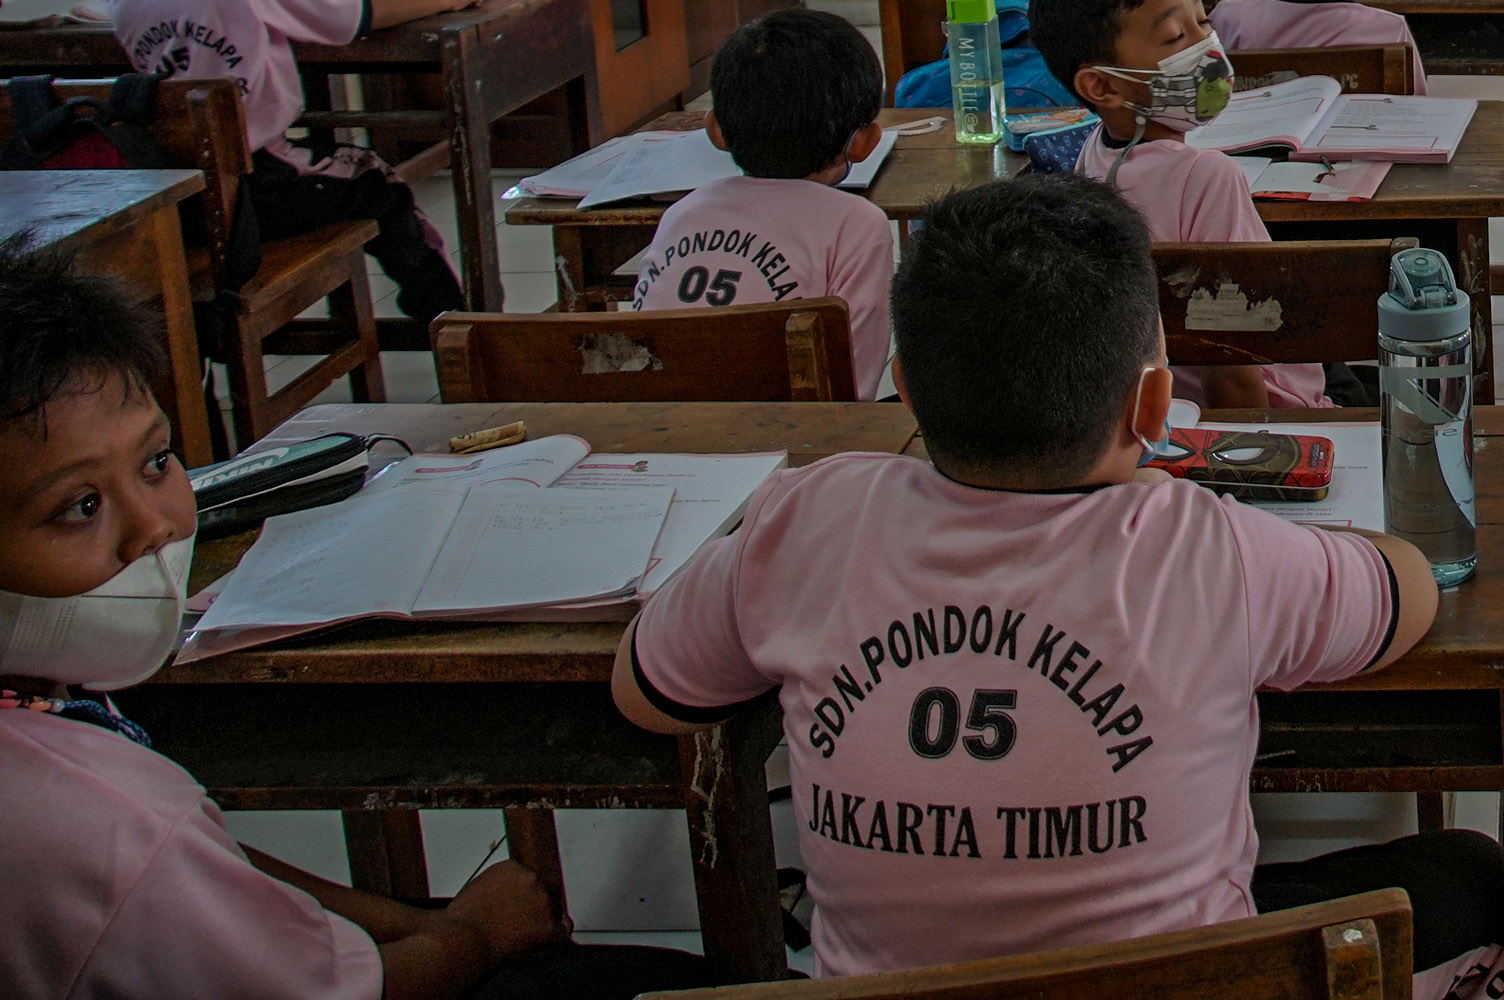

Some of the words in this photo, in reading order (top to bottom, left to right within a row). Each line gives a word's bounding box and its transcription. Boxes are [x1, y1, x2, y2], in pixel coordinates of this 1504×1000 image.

[185, 21, 243, 69] KELAPA
[958, 38, 975, 58] MY
[960, 62, 978, 112] BOTTLE
[677, 265, 743, 307] 05
[751, 241, 803, 300] KELA
[908, 686, 1018, 760] 05
[1027, 623, 1154, 774] KELAPA
[808, 783, 982, 859] JAKARTA
[996, 795, 1148, 860] TIMUR
